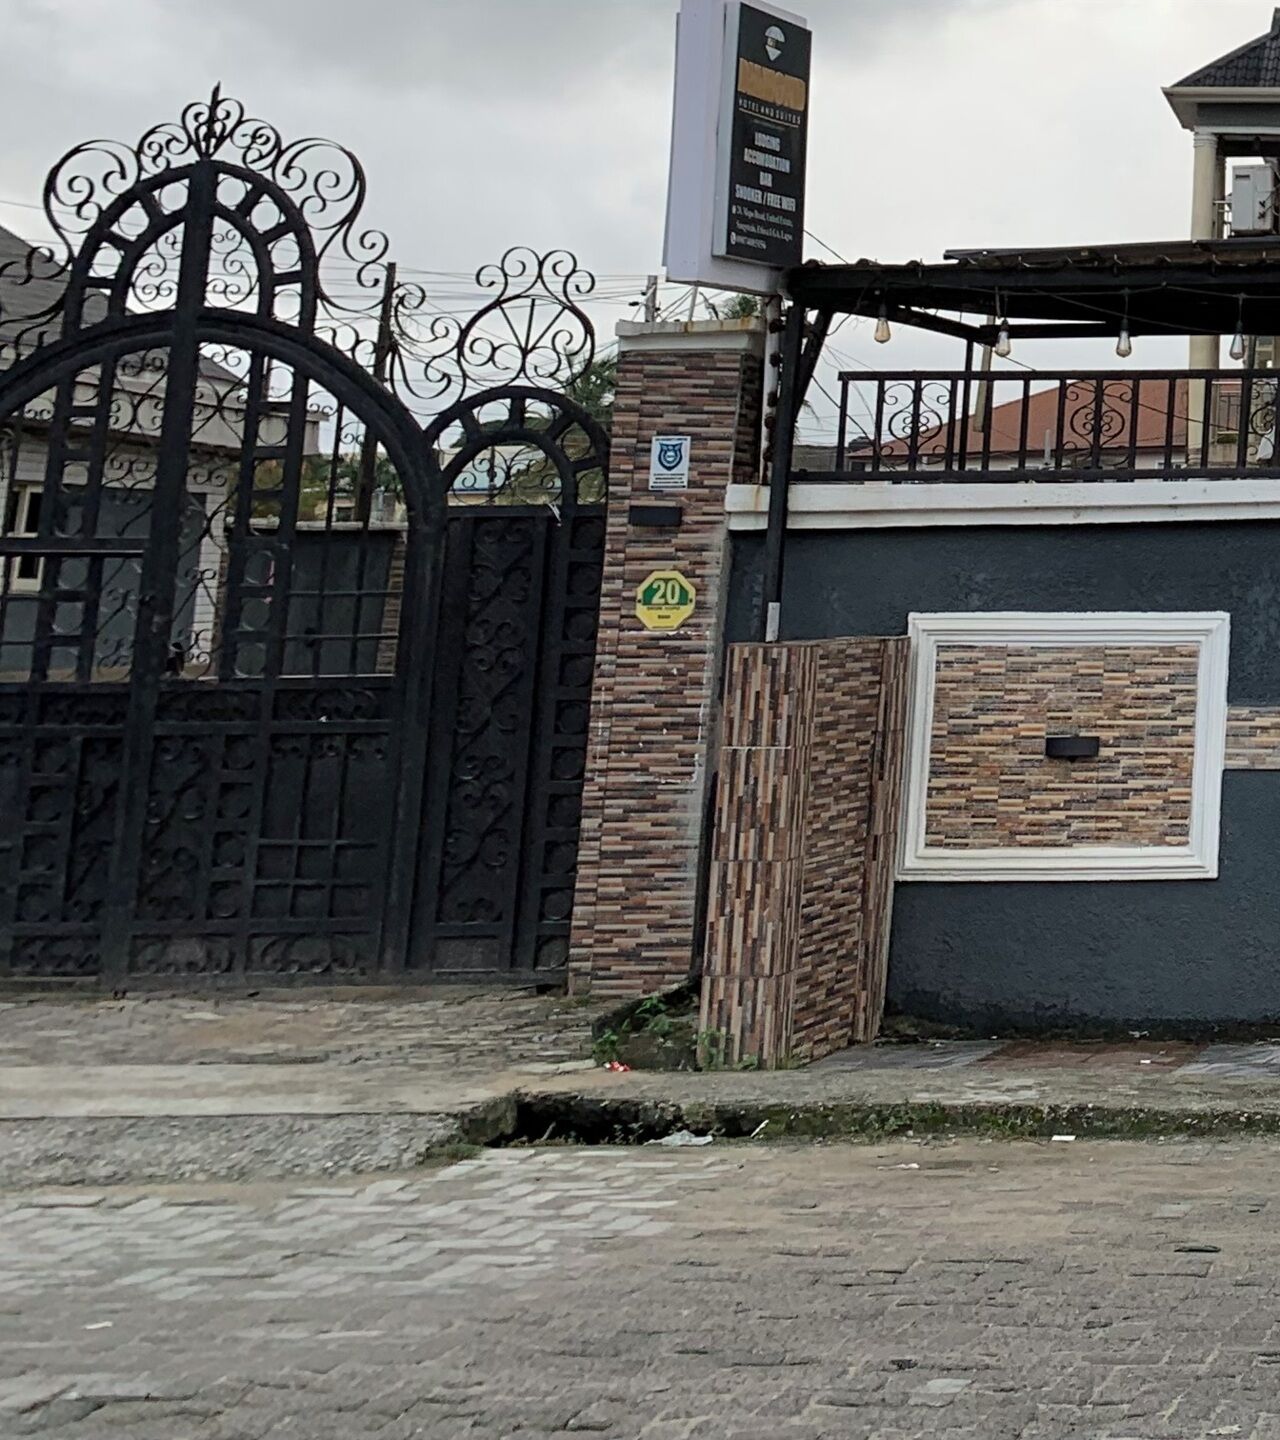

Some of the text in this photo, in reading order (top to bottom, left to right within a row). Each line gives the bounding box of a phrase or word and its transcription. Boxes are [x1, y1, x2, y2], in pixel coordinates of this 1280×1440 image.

[760, 105, 774, 118] AND
[767, 192, 781, 209] FREE
[651, 579, 681, 605] 20
